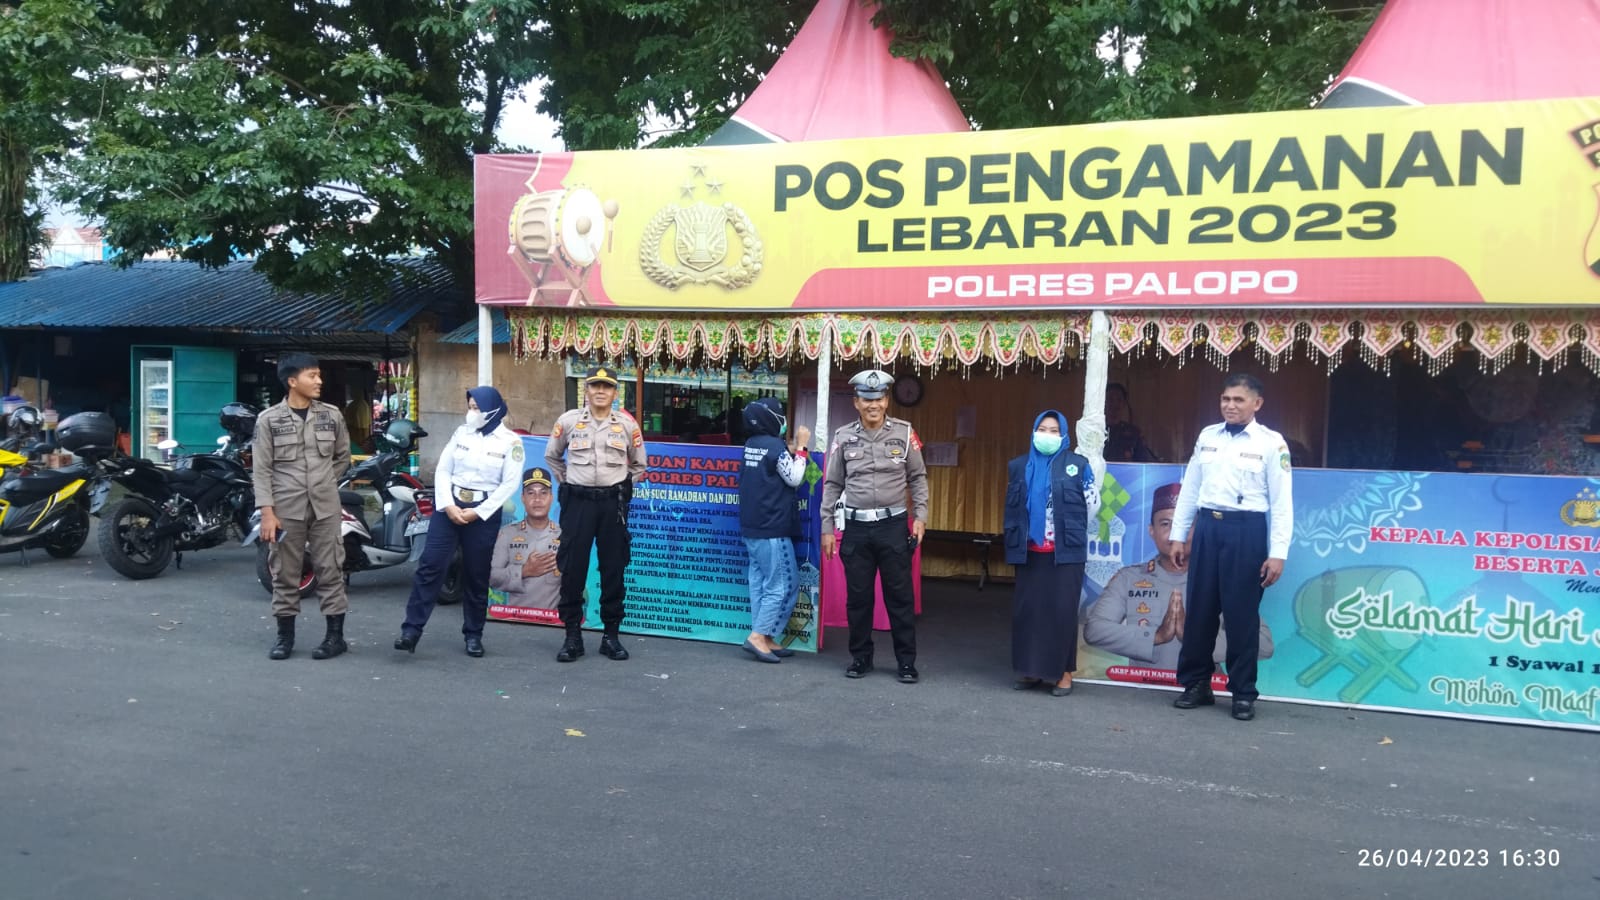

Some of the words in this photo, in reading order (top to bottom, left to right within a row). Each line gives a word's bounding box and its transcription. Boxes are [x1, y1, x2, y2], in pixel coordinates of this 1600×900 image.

[774, 158, 904, 212] POS
[924, 127, 1524, 207] PENGAMANAN
[857, 208, 1170, 253] LEBARAN
[1187, 201, 1398, 244] 2023
[927, 272, 1094, 299] POLRES
[1105, 269, 1298, 297] PALOPO
[639, 471, 702, 486] POLRES
[651, 489, 667, 500] SUCI
[668, 490, 707, 503] RAMADHAN
[709, 494, 724, 505] DAN
[1369, 526, 1467, 546] KEPALA
[1474, 555, 1587, 576] BESERTA
[1486, 595, 1589, 647] Hari
[1488, 656, 1498, 667] 1
[1506, 655, 1583, 673] Syawal
